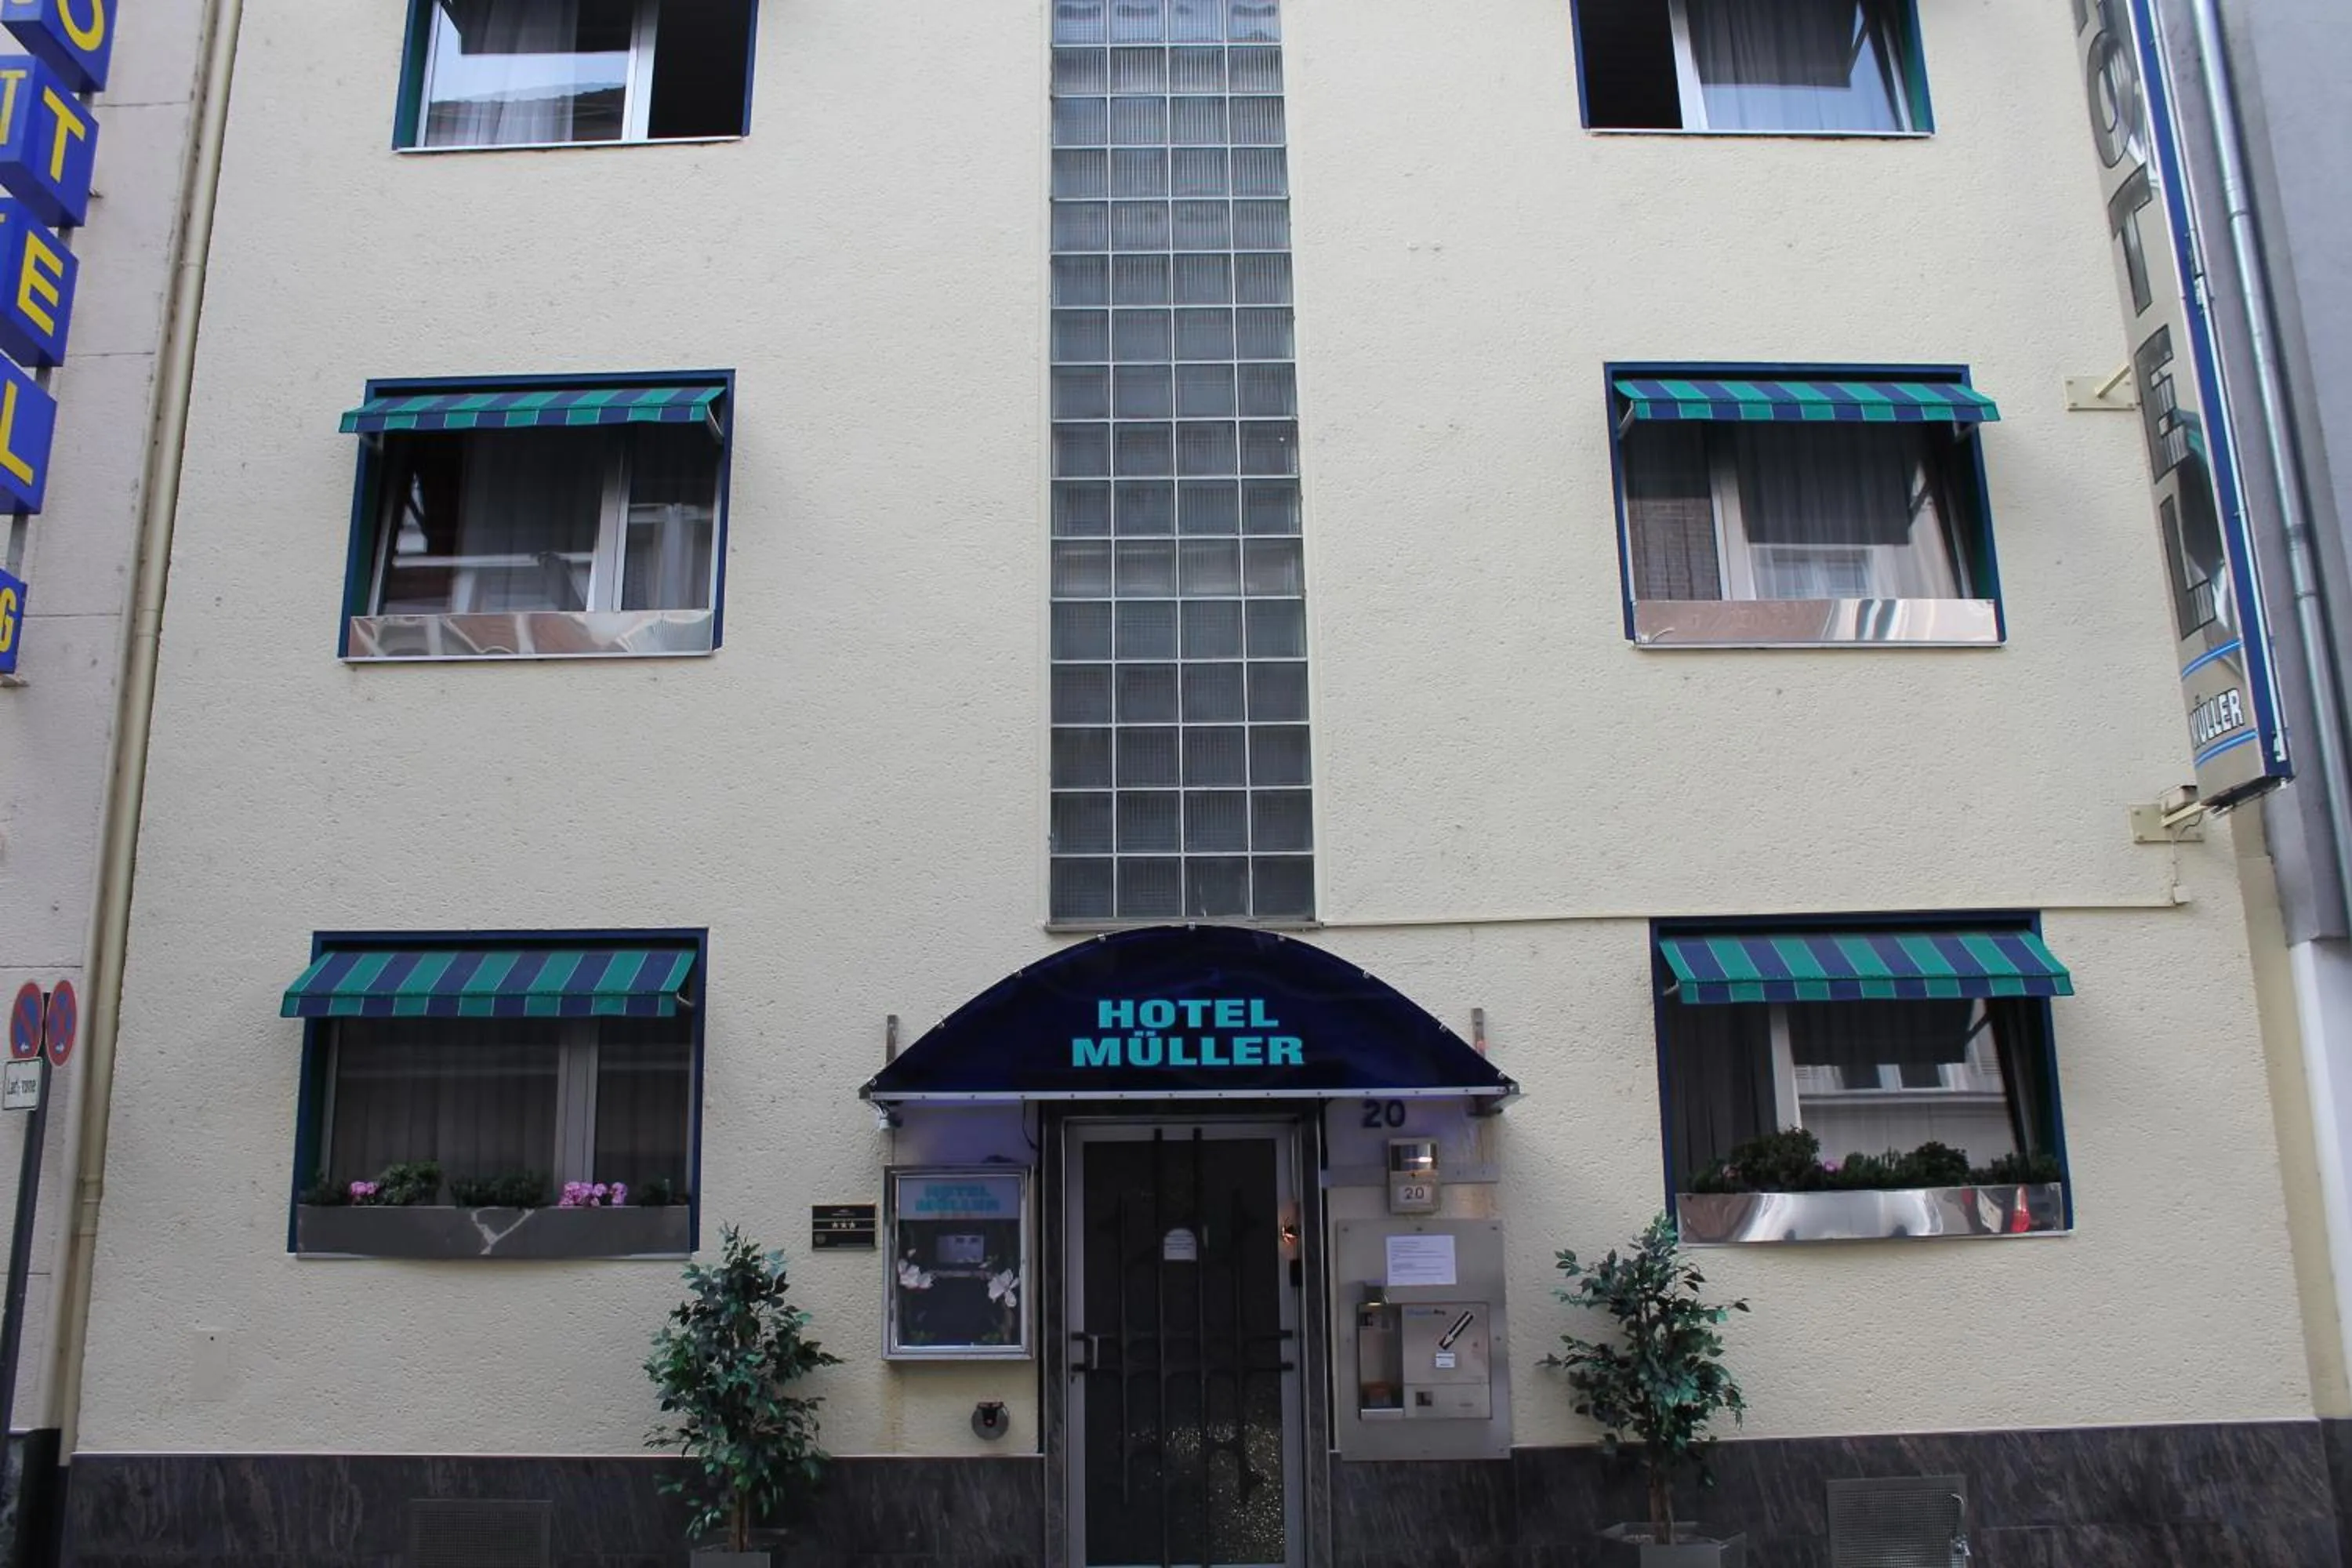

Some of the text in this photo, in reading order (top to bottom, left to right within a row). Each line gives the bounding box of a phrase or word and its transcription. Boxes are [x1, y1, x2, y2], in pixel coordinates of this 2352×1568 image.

[2070, 0, 2216, 641] OTEL
[1098, 999, 1279, 1029] HOTEL
[1071, 1031, 1305, 1067] MÜLLER
[1362, 1098, 1406, 1127] 20
[1404, 1186, 1425, 1200] 20
